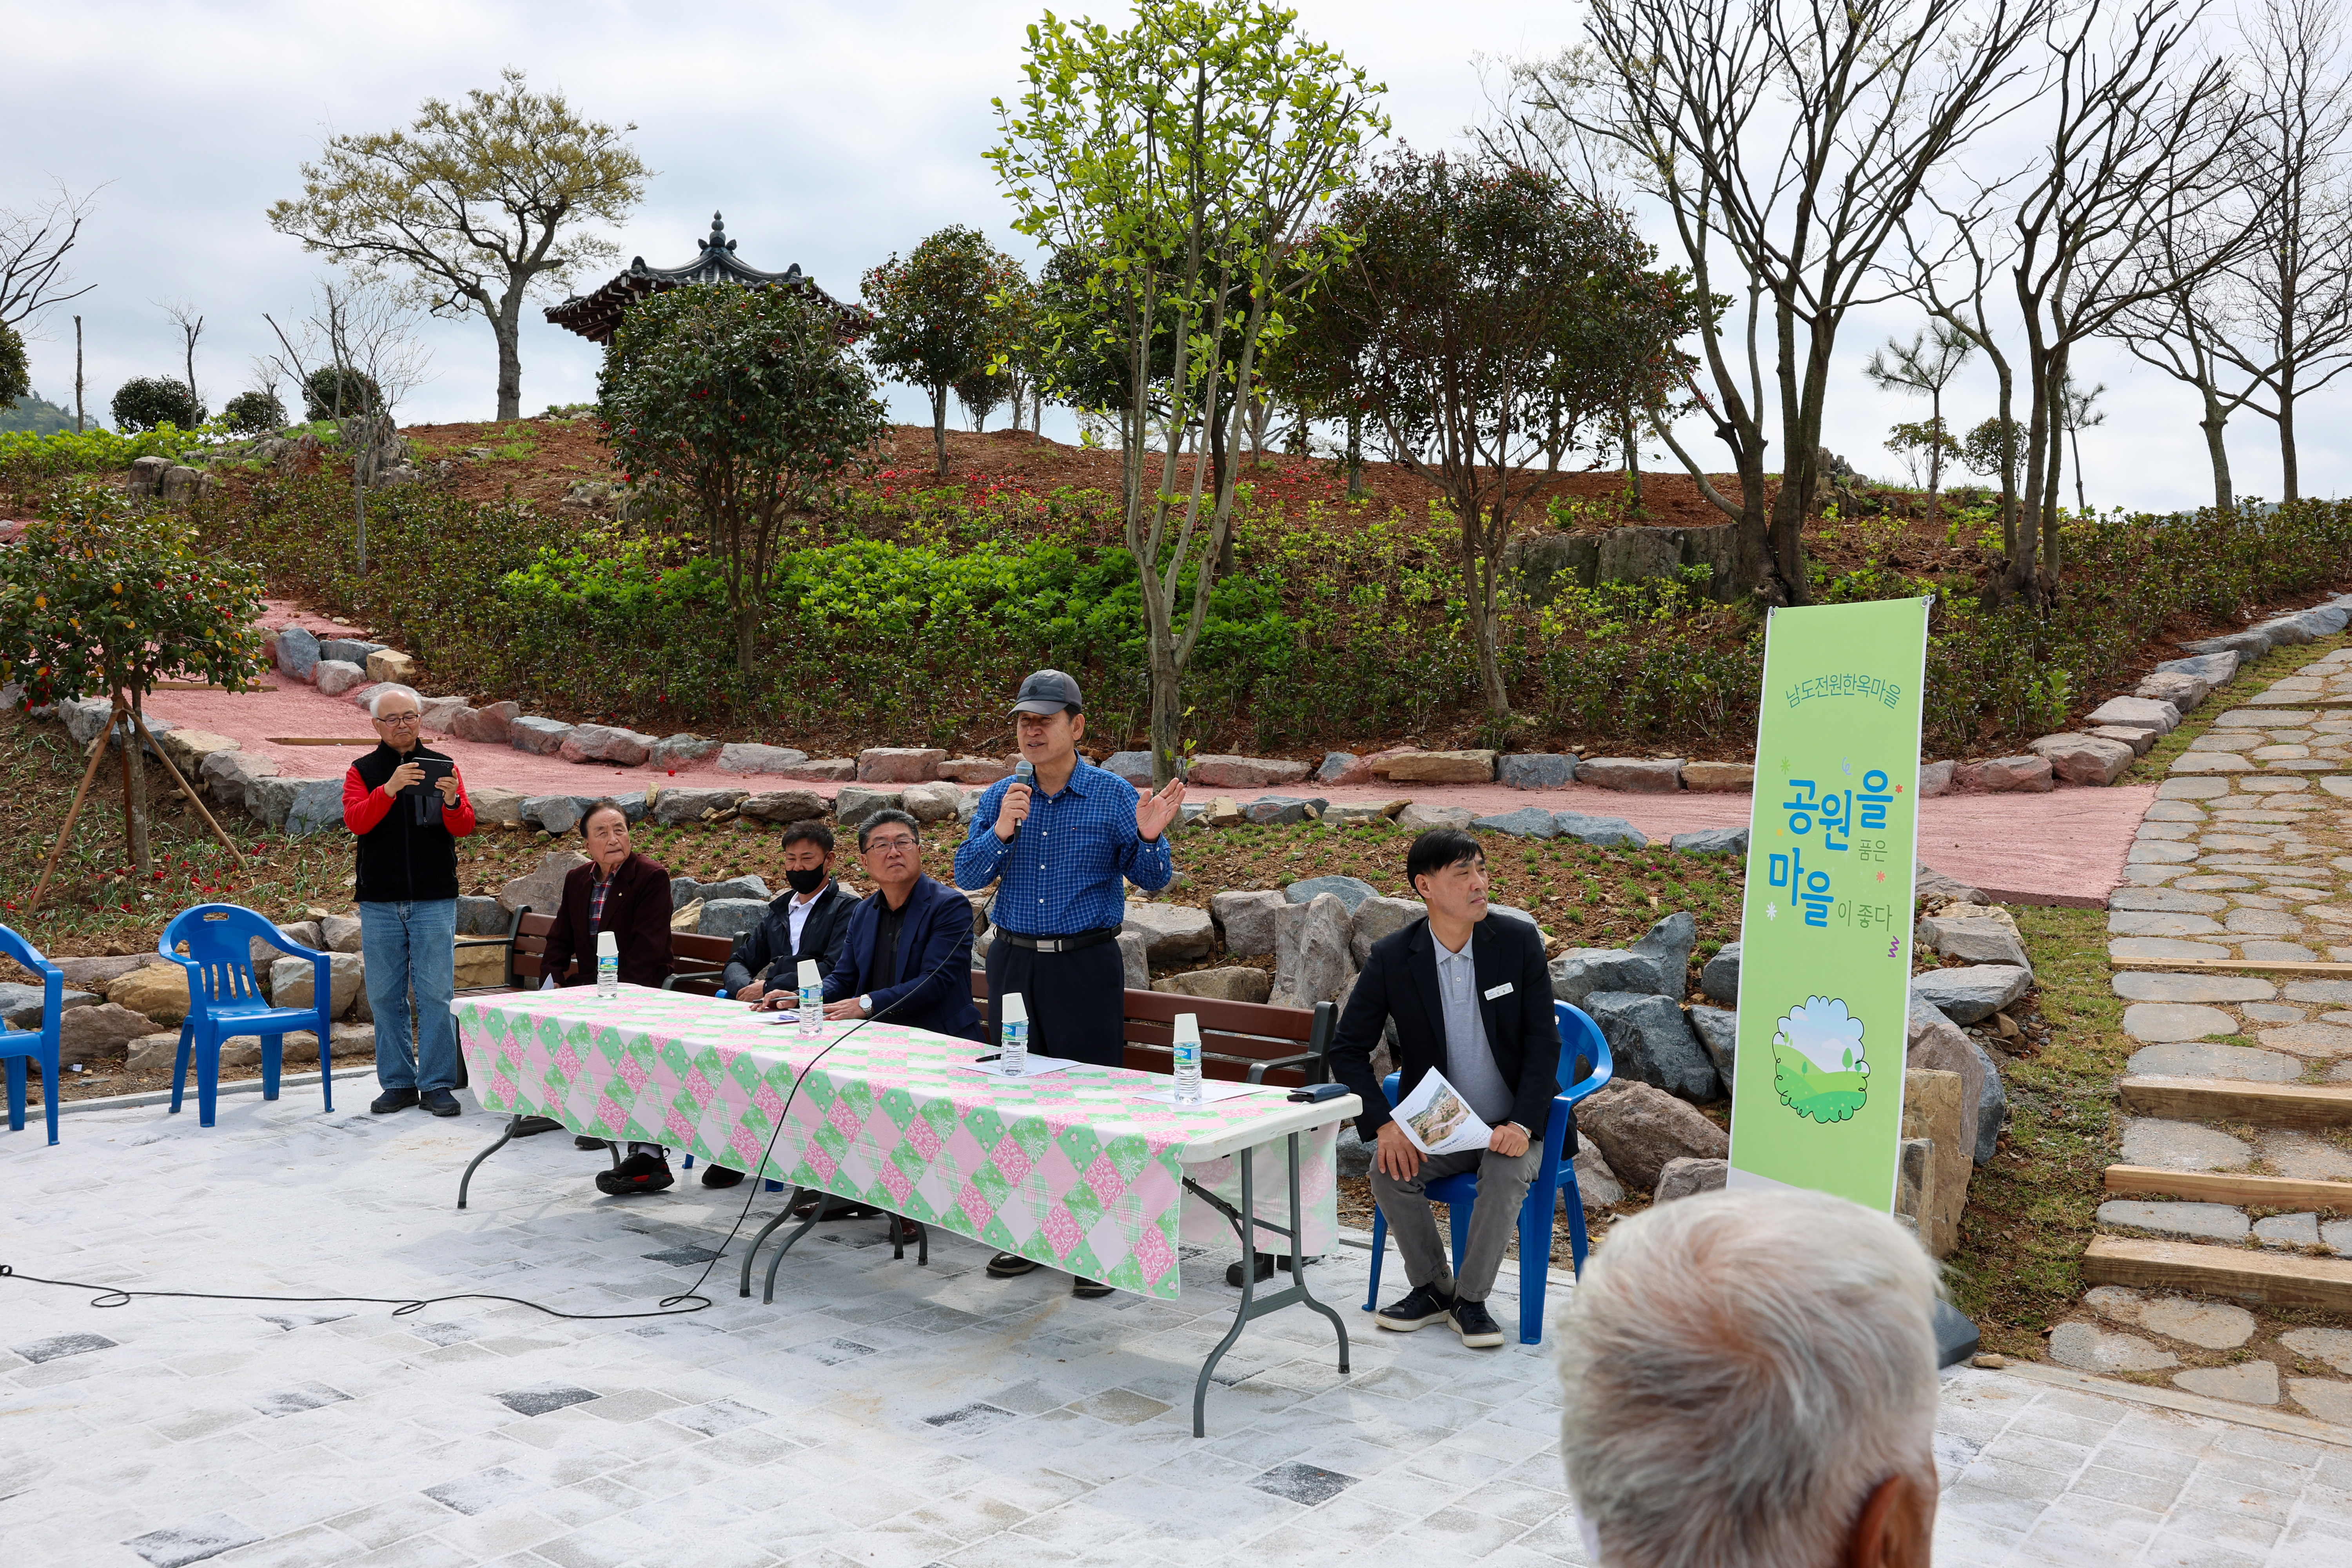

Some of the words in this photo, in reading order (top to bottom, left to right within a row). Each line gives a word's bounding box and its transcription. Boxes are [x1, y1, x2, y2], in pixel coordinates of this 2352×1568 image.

[1785, 673, 1901, 710] 남도전원한옥마을
[1782, 769, 1894, 852] 공원을
[1858, 839, 1888, 862] 품은
